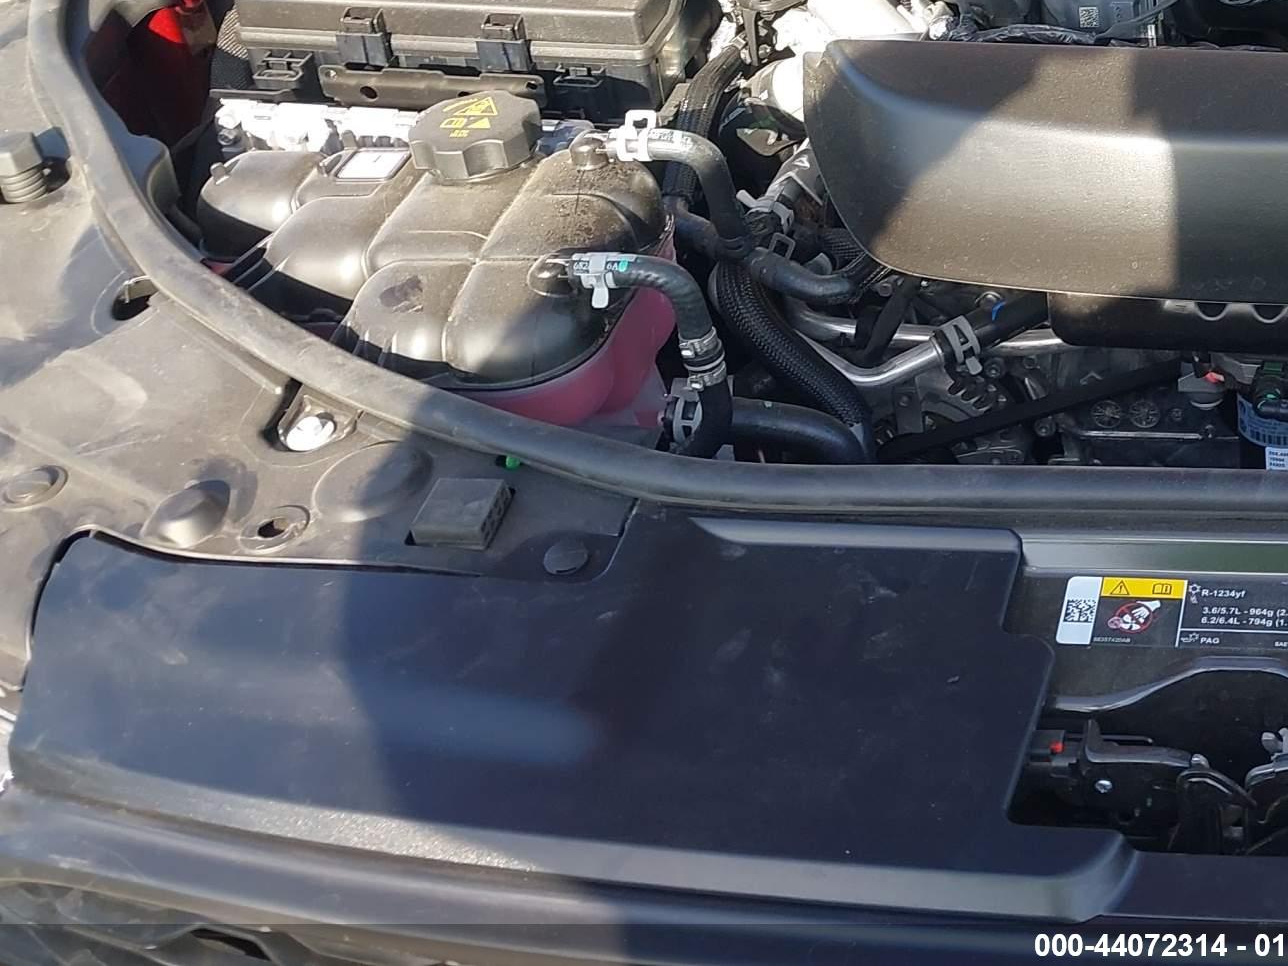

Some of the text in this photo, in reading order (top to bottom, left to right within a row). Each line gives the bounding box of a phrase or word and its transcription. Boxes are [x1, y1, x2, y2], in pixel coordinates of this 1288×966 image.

[1201, 589, 1246, 599] R-1234yf
[1202, 607, 1241, 615] 3.6/5.7L
[1249, 608, 1273, 617] 964g
[1201, 617, 1240, 625] 6.2/6.4L
[1248, 618, 1273, 627] 794g
